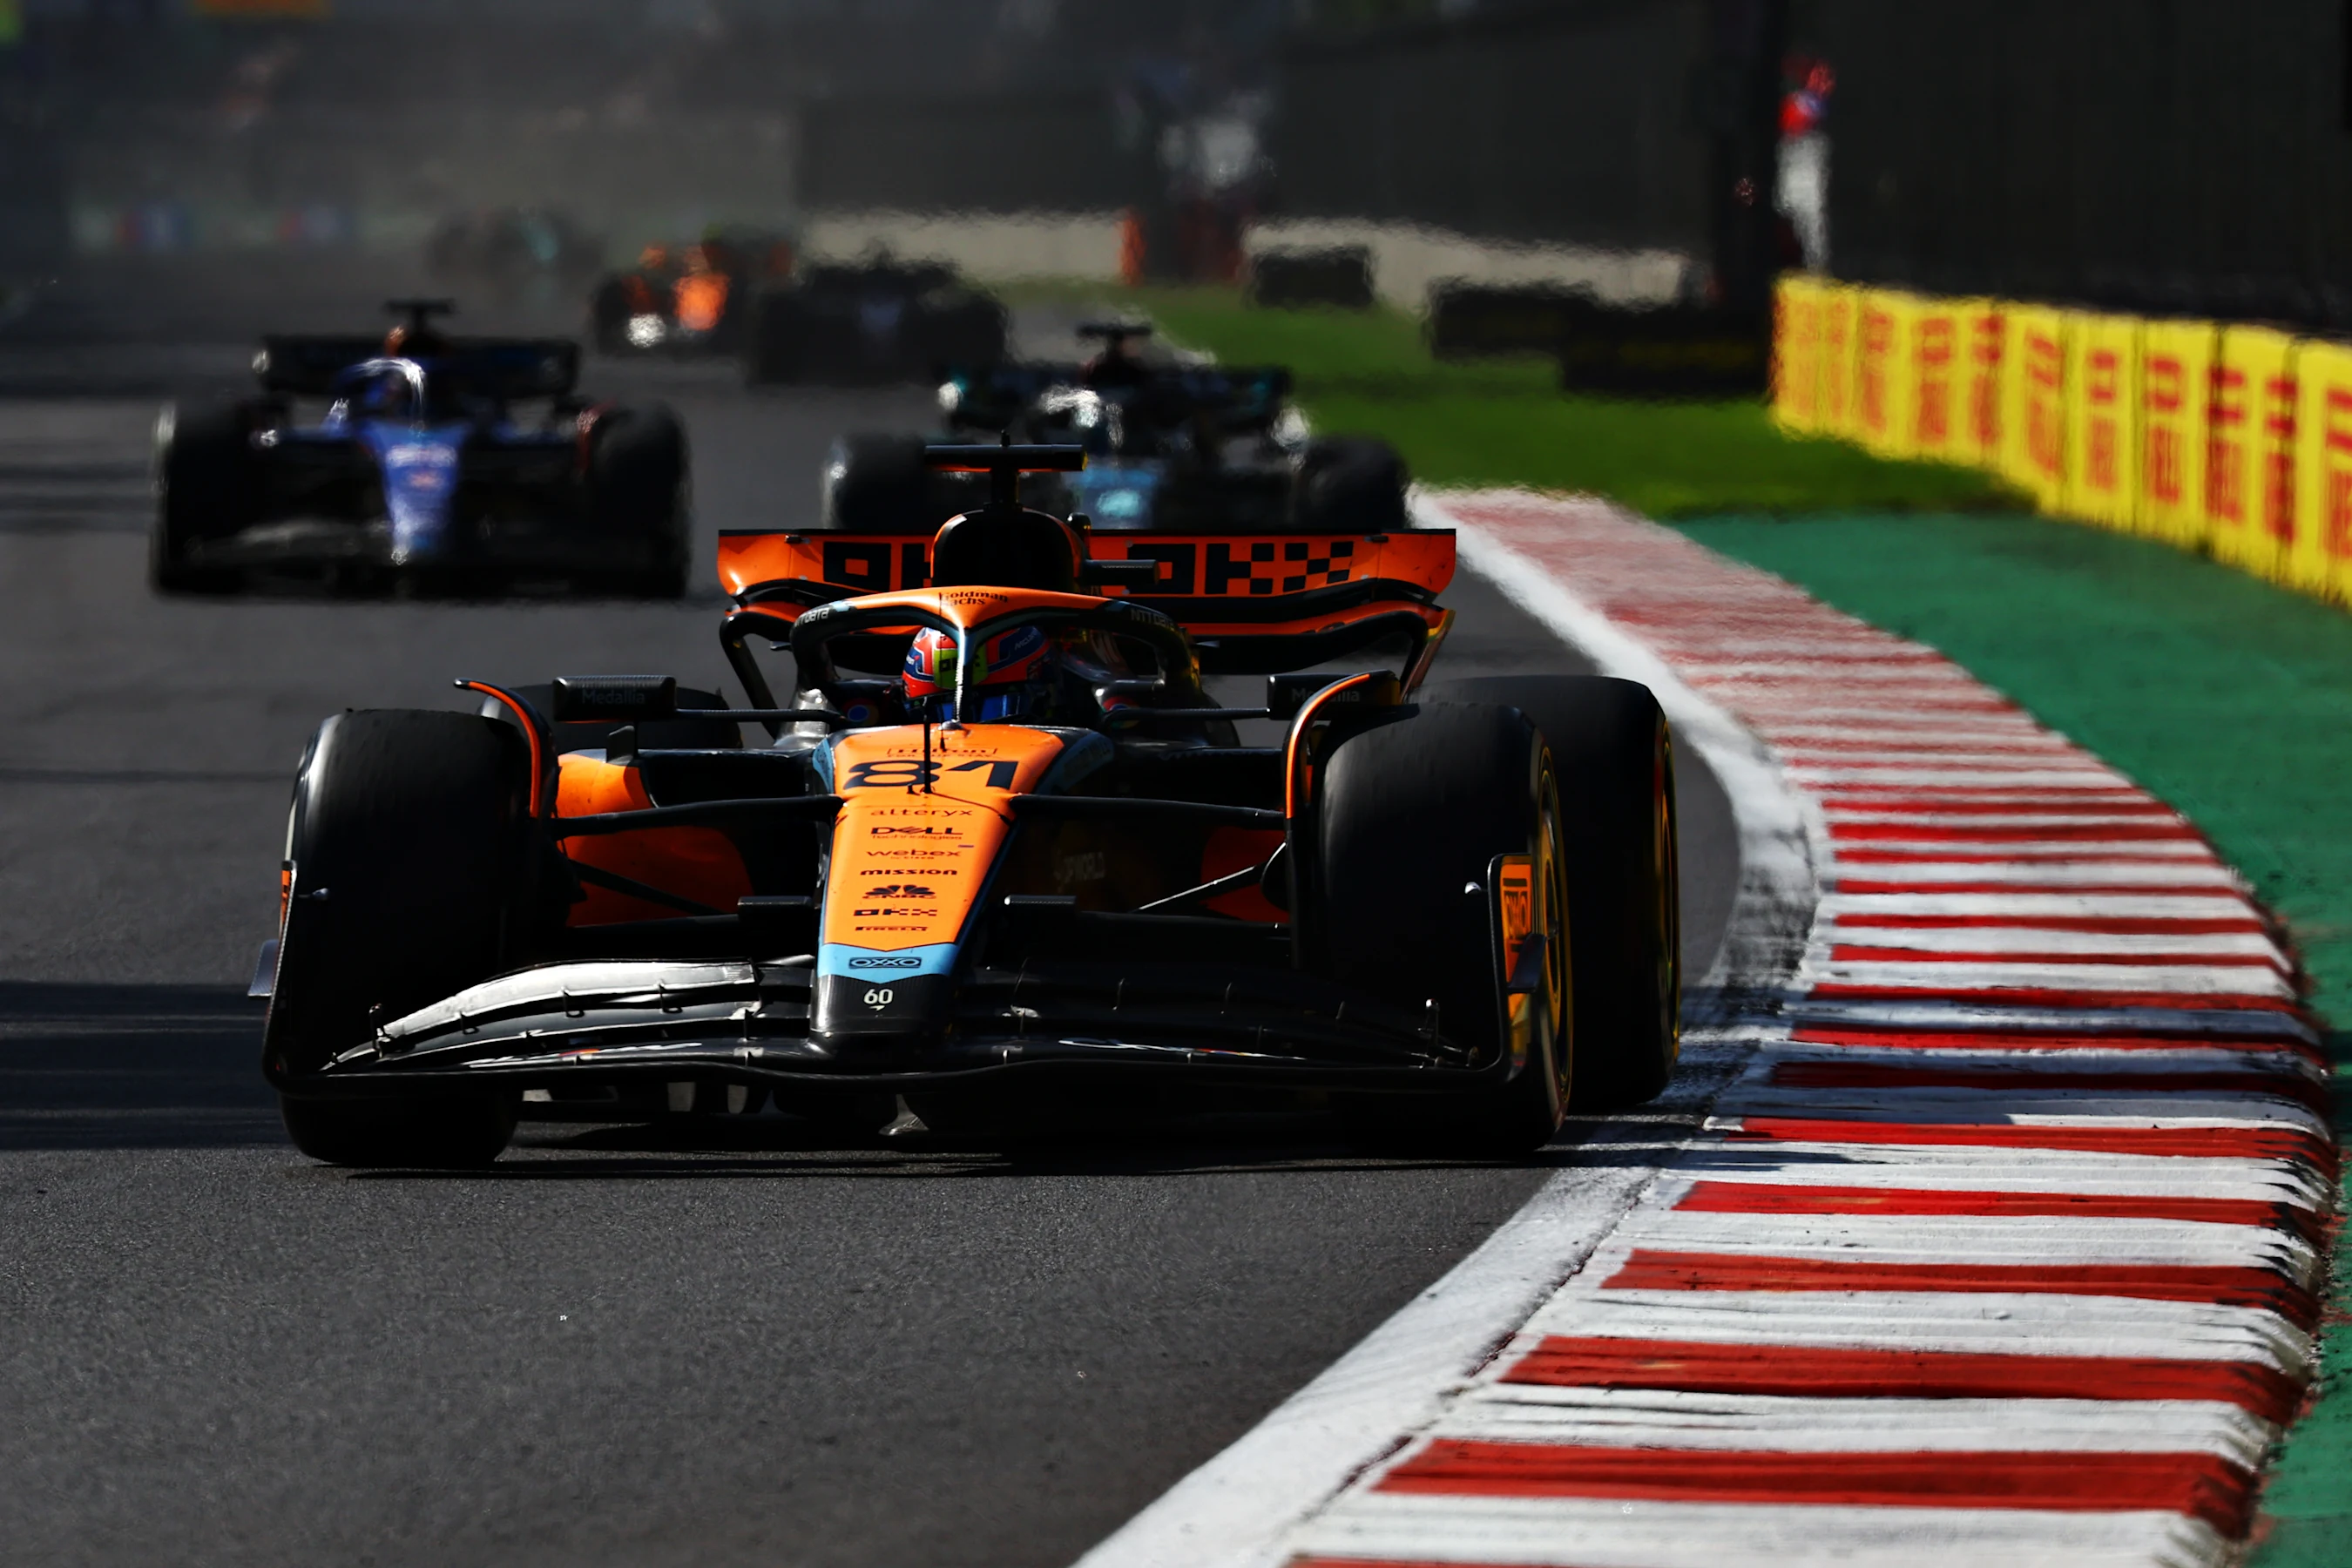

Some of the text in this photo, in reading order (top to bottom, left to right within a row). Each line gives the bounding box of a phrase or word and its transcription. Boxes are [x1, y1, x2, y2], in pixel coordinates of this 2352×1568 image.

[581, 689, 645, 705] Medallia
[843, 760, 1018, 790] 81
[871, 808, 973, 816] alteryx
[871, 826, 963, 835] DELL
[867, 848, 961, 857] webex
[854, 908, 938, 916] OKX
[849, 957, 922, 969] OXXO
[862, 988, 895, 1005] 60
